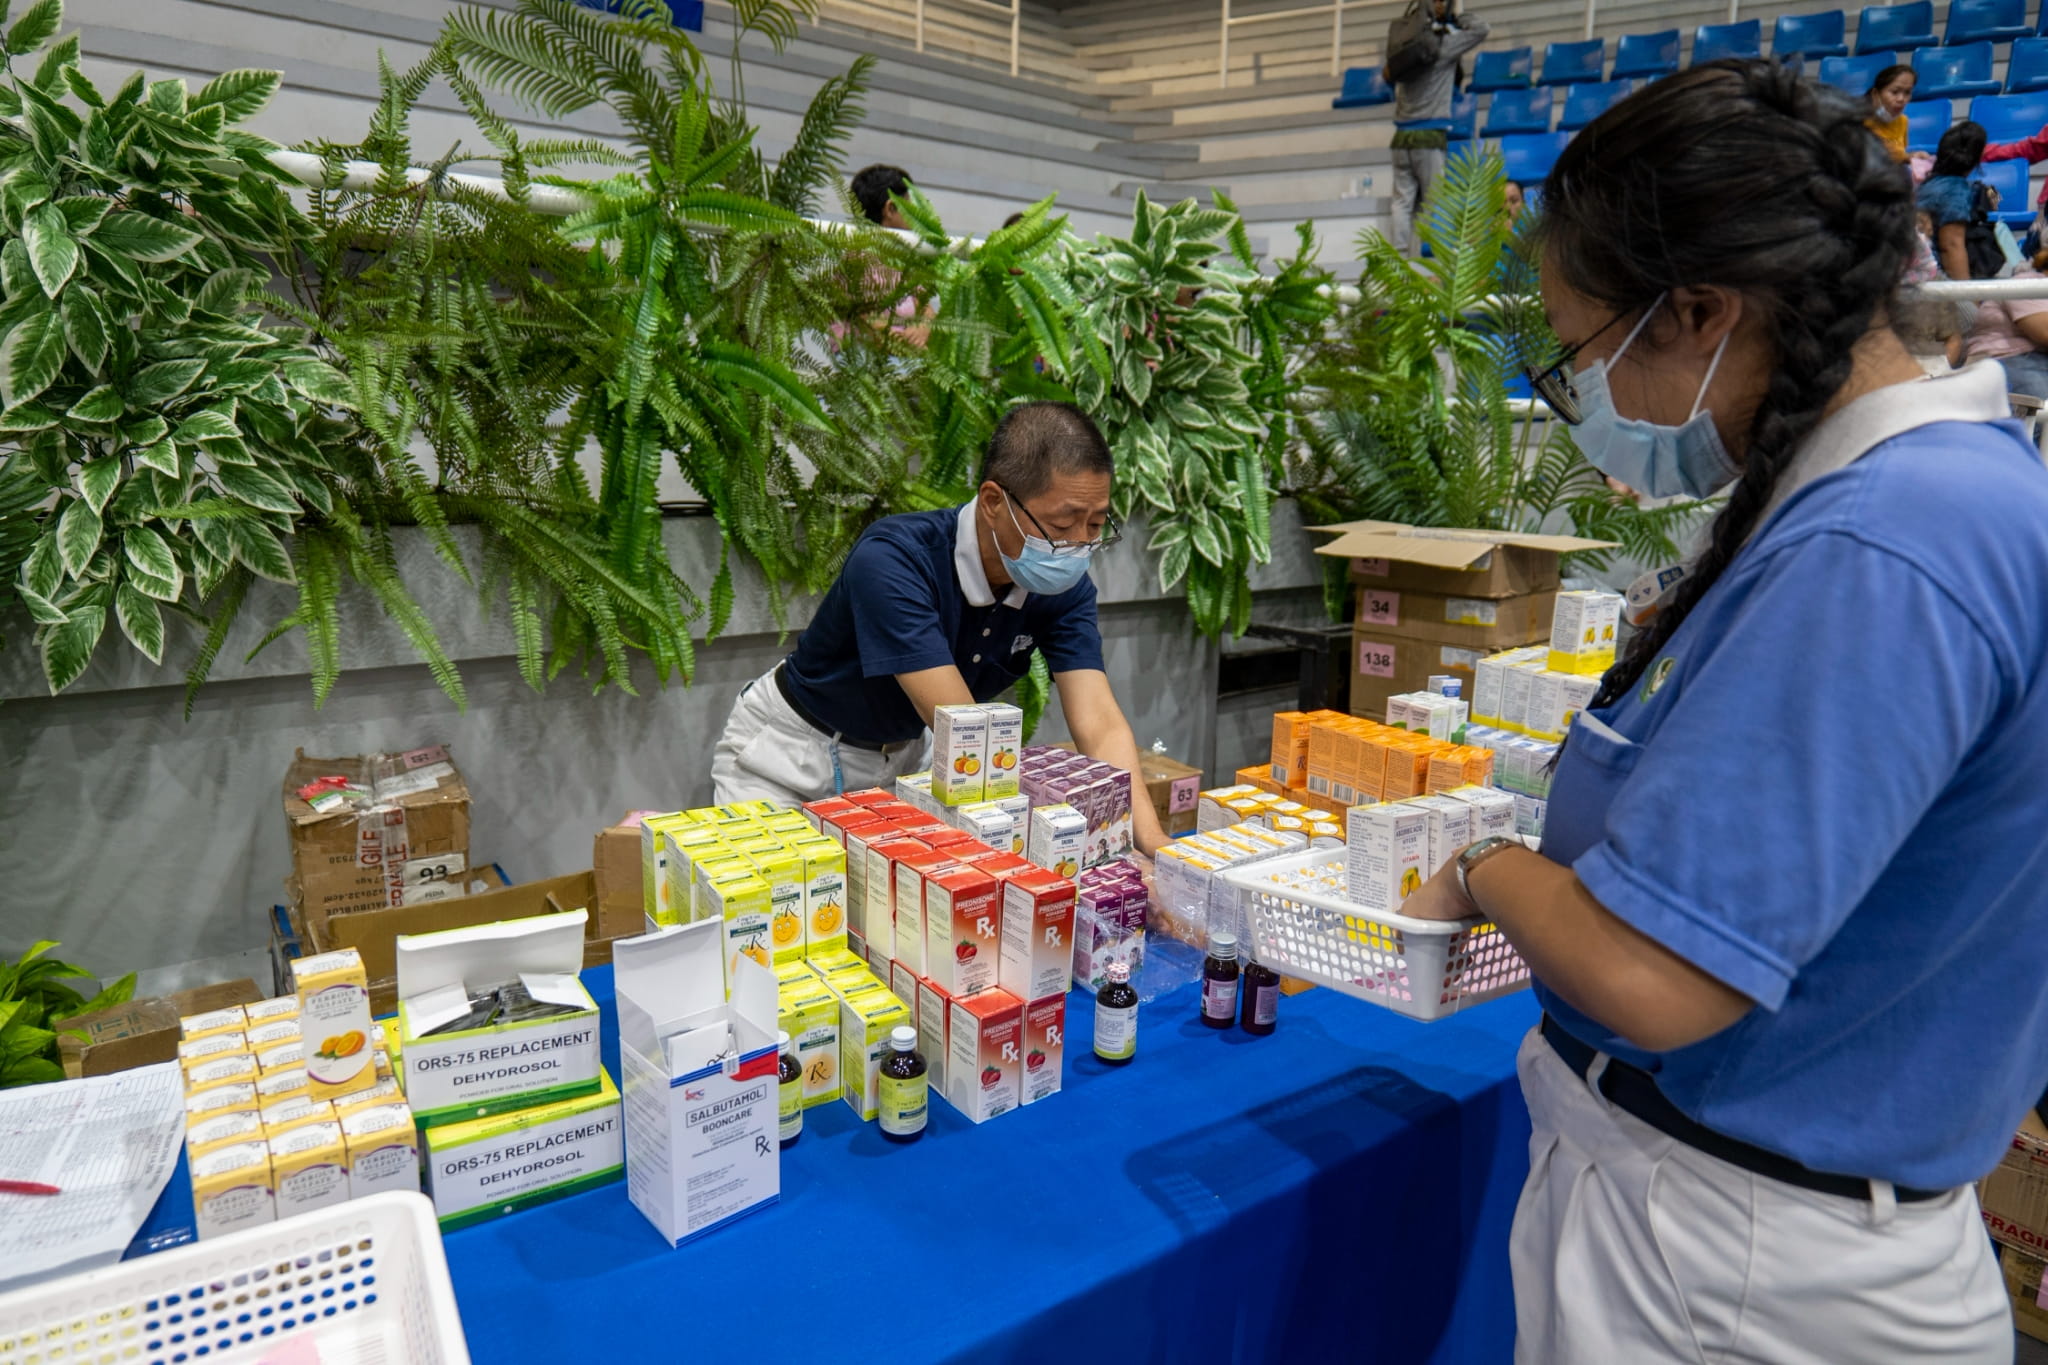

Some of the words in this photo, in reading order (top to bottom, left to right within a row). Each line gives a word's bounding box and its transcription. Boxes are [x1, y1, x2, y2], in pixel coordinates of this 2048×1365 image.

[1371, 600, 1389, 614] 34
[1365, 652, 1390, 667] 138
[1177, 787, 1193, 802] 63
[417, 1052, 475, 1071] ORS-75
[479, 1030, 593, 1062] REPLACEMENT
[453, 1059, 561, 1086] DEHYDROSOL
[690, 1088, 763, 1124] SALBUTAMOL
[702, 1107, 753, 1135] BOONCARE
[445, 1148, 501, 1175] ORS-75
[504, 1119, 614, 1157] REPLACEMENT
[480, 1150, 585, 1186] DEHYDROSOL
[1981, 1210, 2048, 1250] FRAGI
